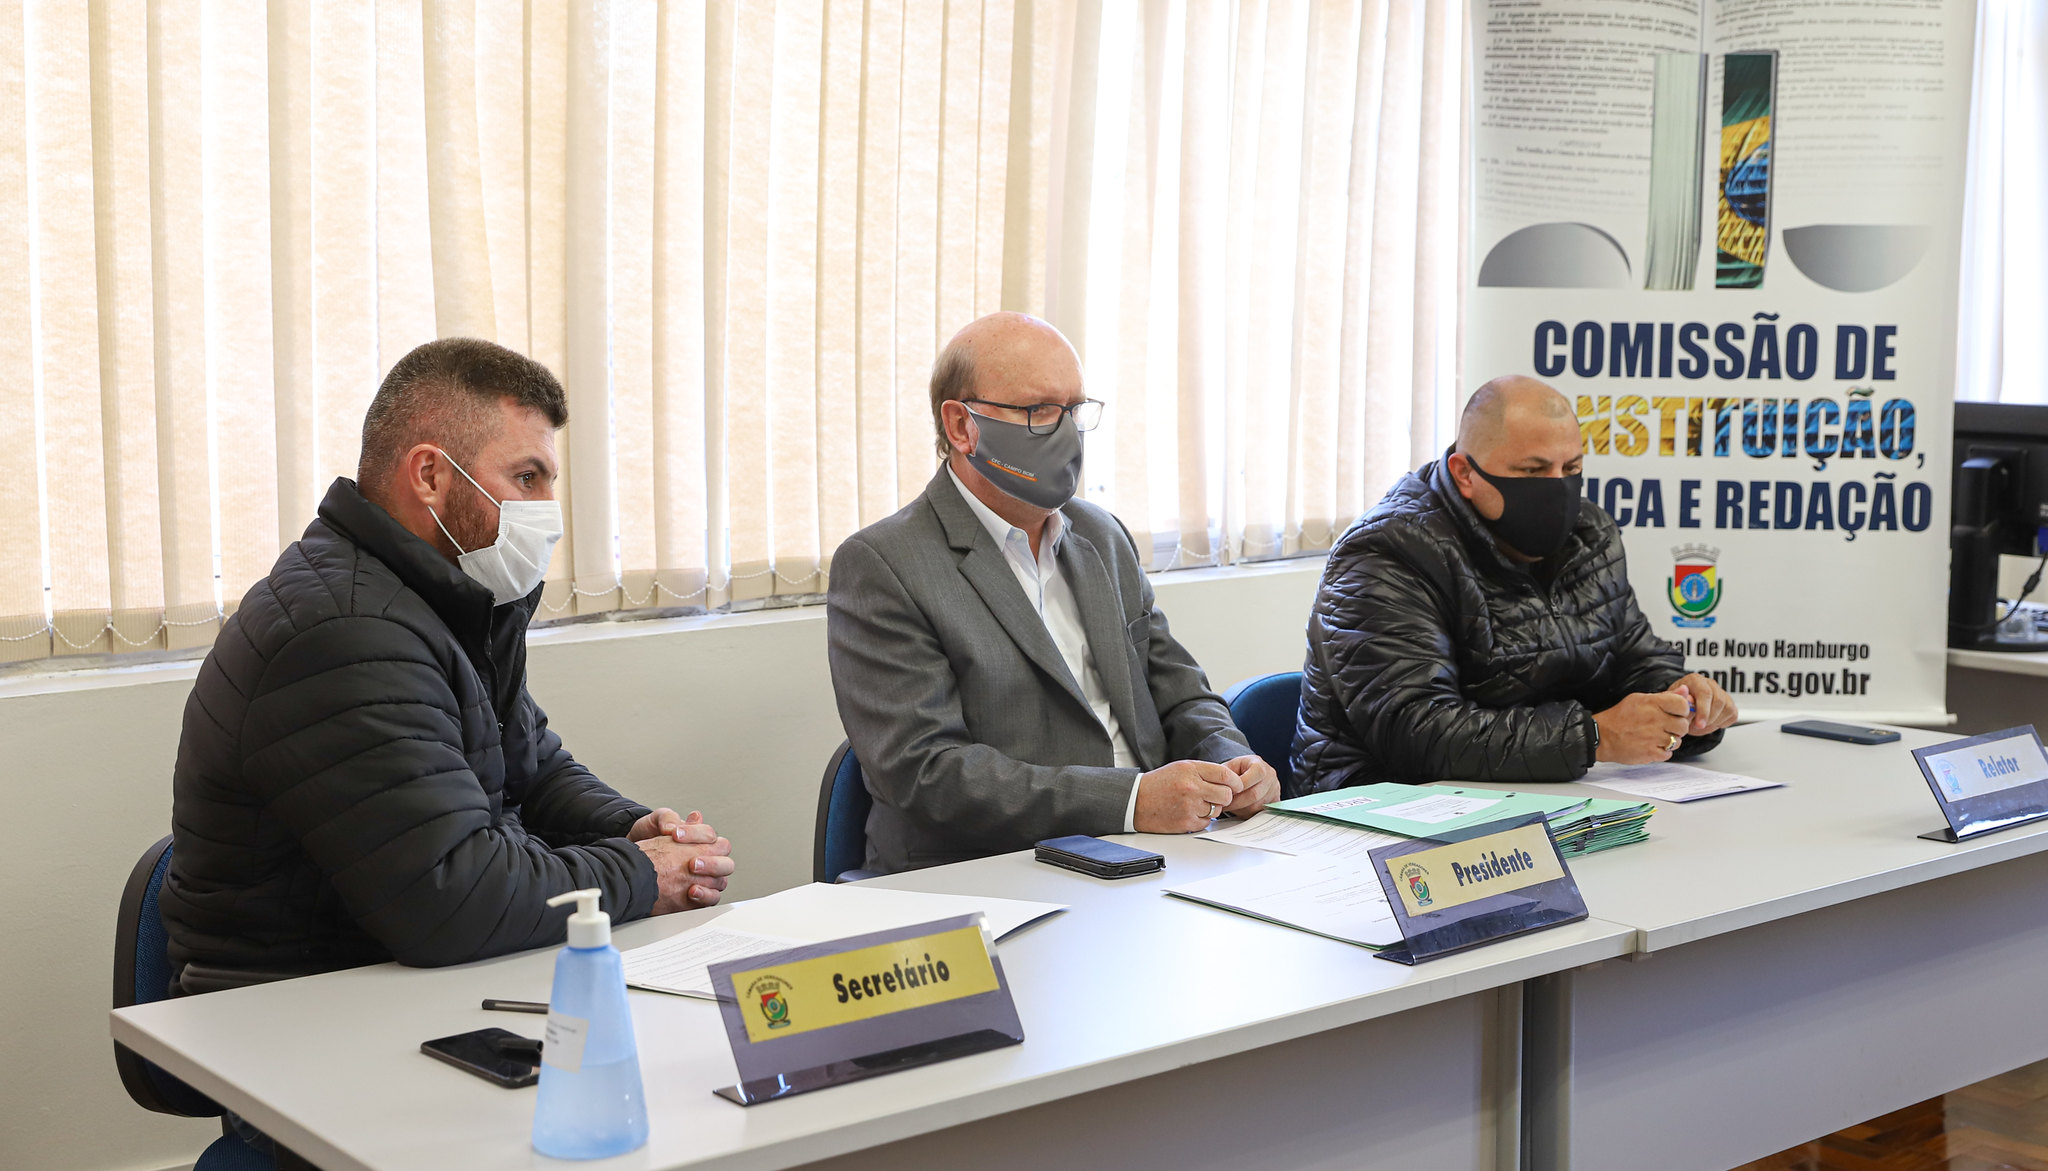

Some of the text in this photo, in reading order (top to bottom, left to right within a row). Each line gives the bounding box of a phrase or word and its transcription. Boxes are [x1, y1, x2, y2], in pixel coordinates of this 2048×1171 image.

[1534, 312, 1897, 381] COMISSÃO DE
[1576, 386, 1925, 471] NSTITUIÇÃO,
[1679, 479, 1701, 529] E
[1715, 472, 1932, 542] REDAÇÃO
[1696, 639, 1719, 657] de
[1725, 639, 1768, 658] Novo
[1774, 640, 1870, 662] Hamburgo
[1977, 755, 2020, 779] Relator
[1451, 847, 1534, 887] Presidente
[833, 953, 950, 1004] Secretário
